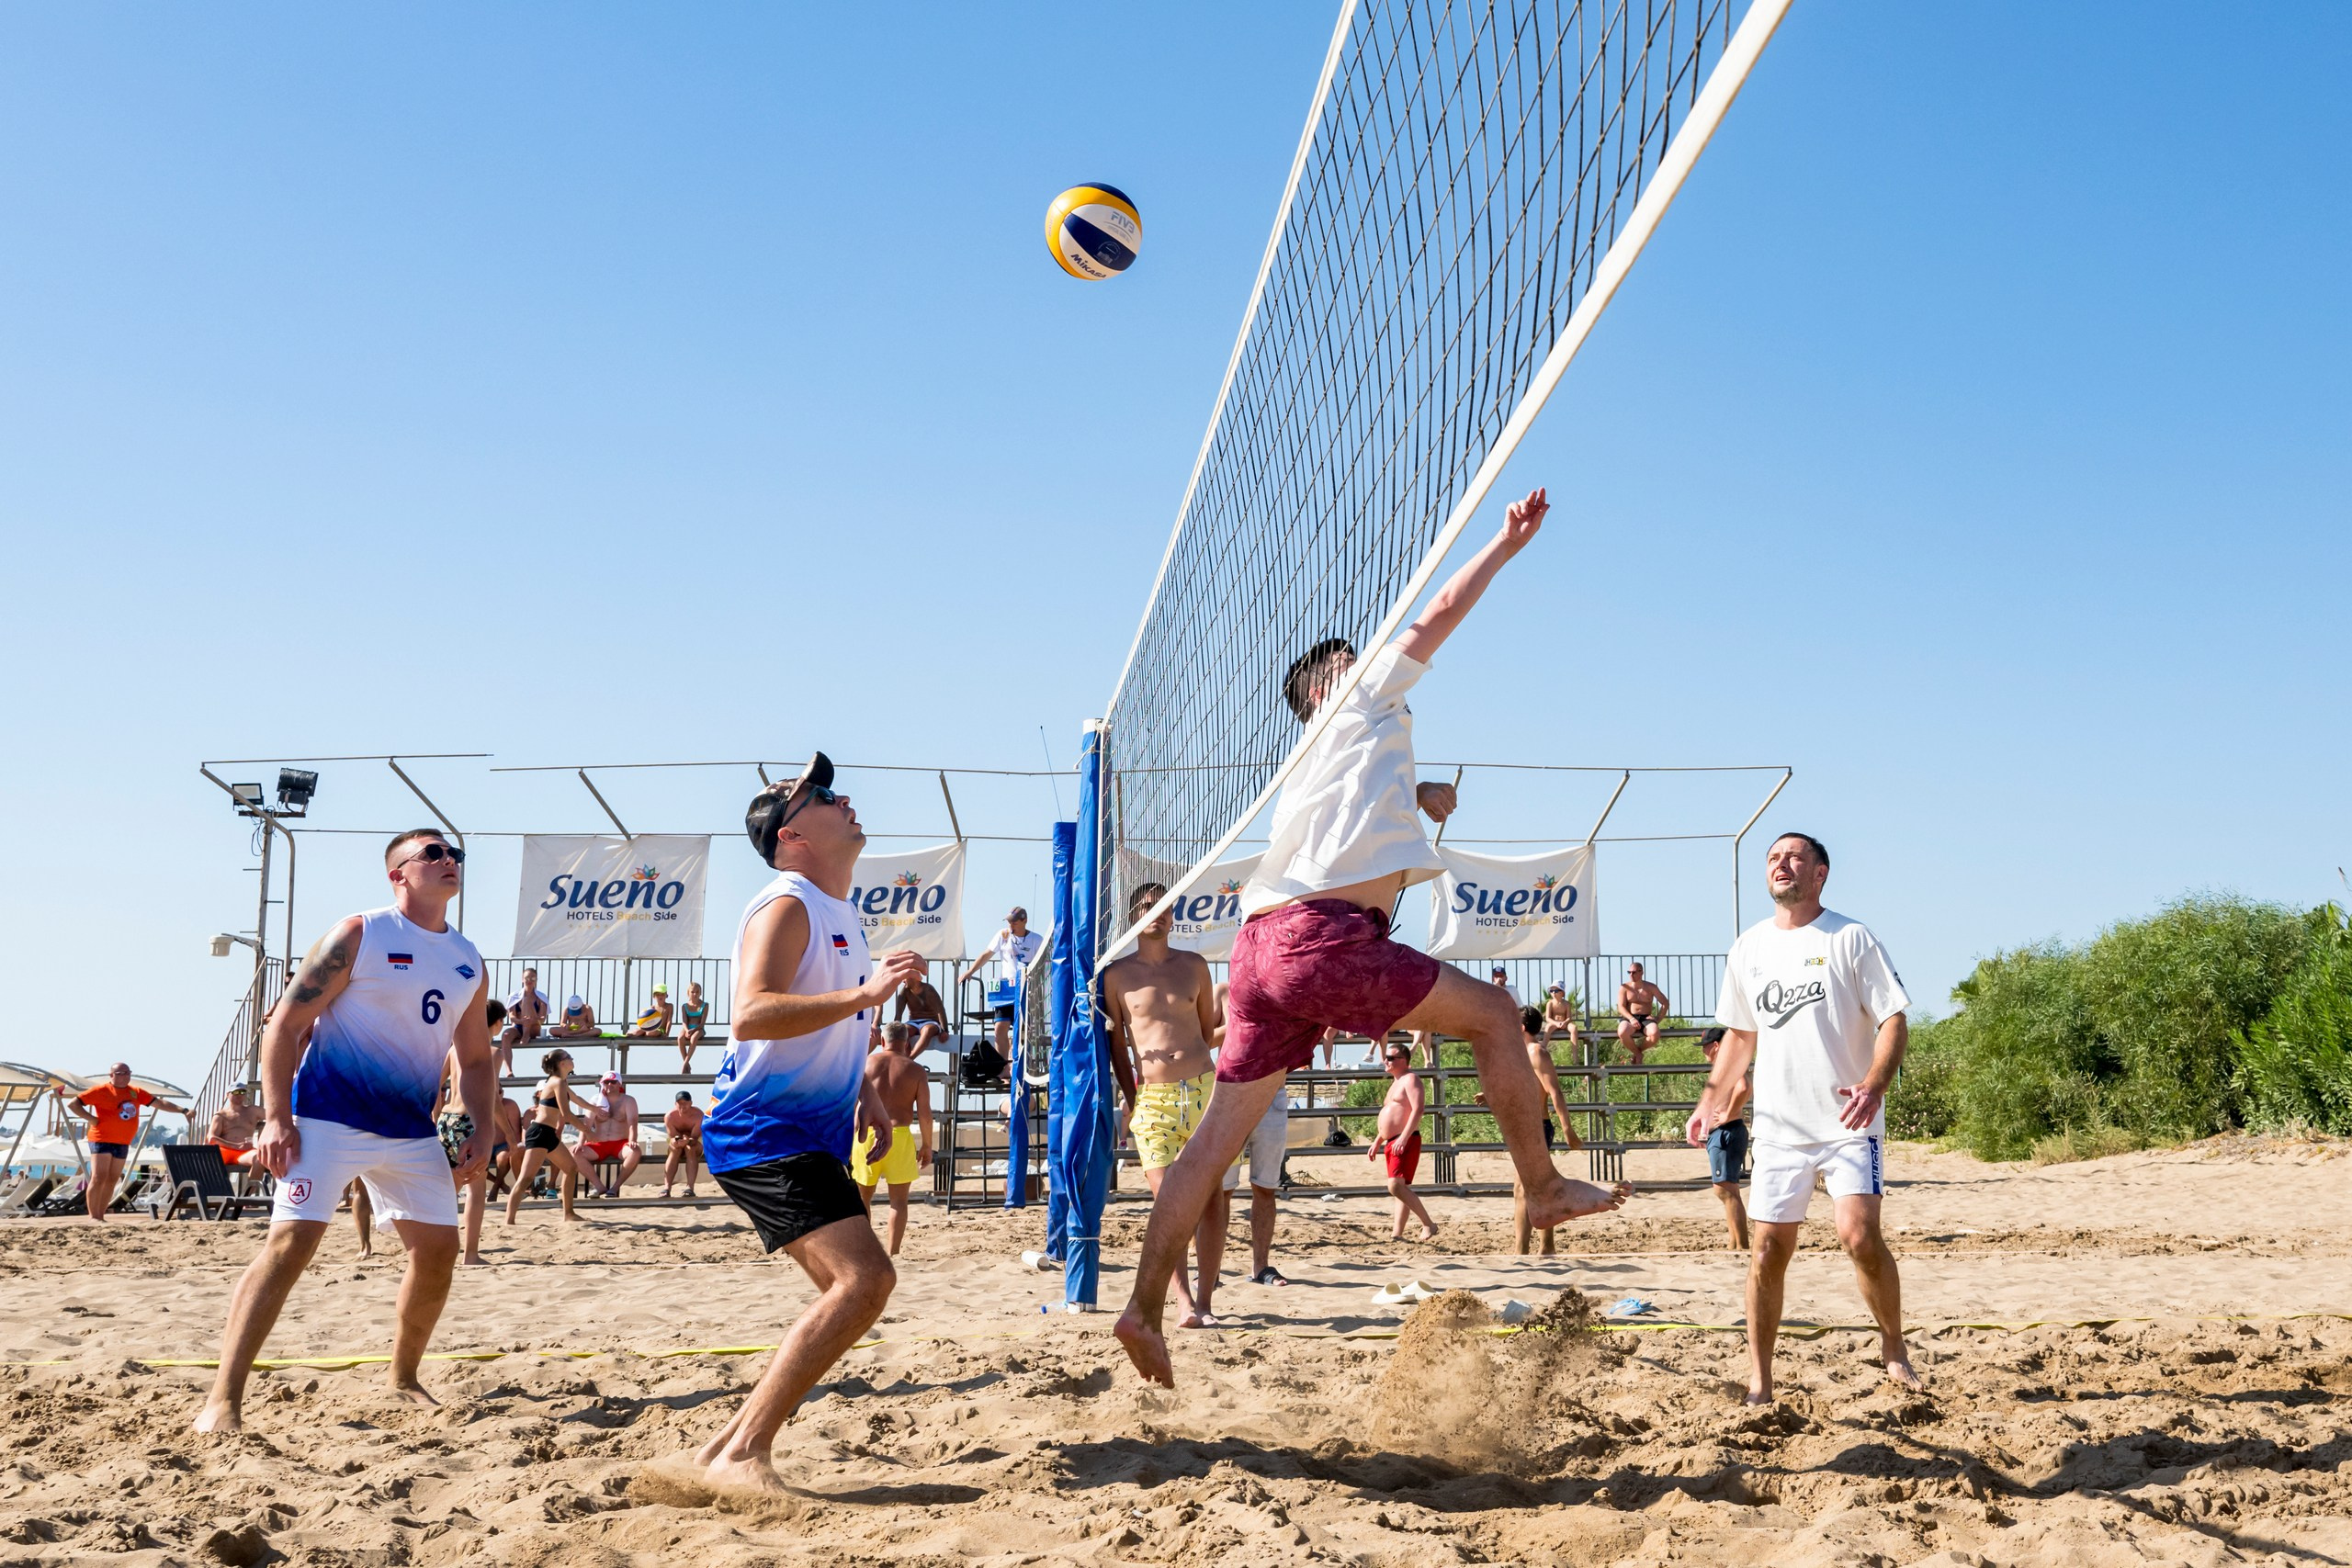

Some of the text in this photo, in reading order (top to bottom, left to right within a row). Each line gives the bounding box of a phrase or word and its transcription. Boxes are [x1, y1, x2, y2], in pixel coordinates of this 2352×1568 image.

[567, 910, 677, 921] HOTELS Beach Side
[881, 917, 915, 927] Beach
[917, 914, 942, 924] Side
[1476, 915, 1574, 928] HOTELS Beach Side
[1204, 919, 1236, 932] Beach
[989, 980, 1000, 992] 16
[422, 988, 445, 1025] 6
